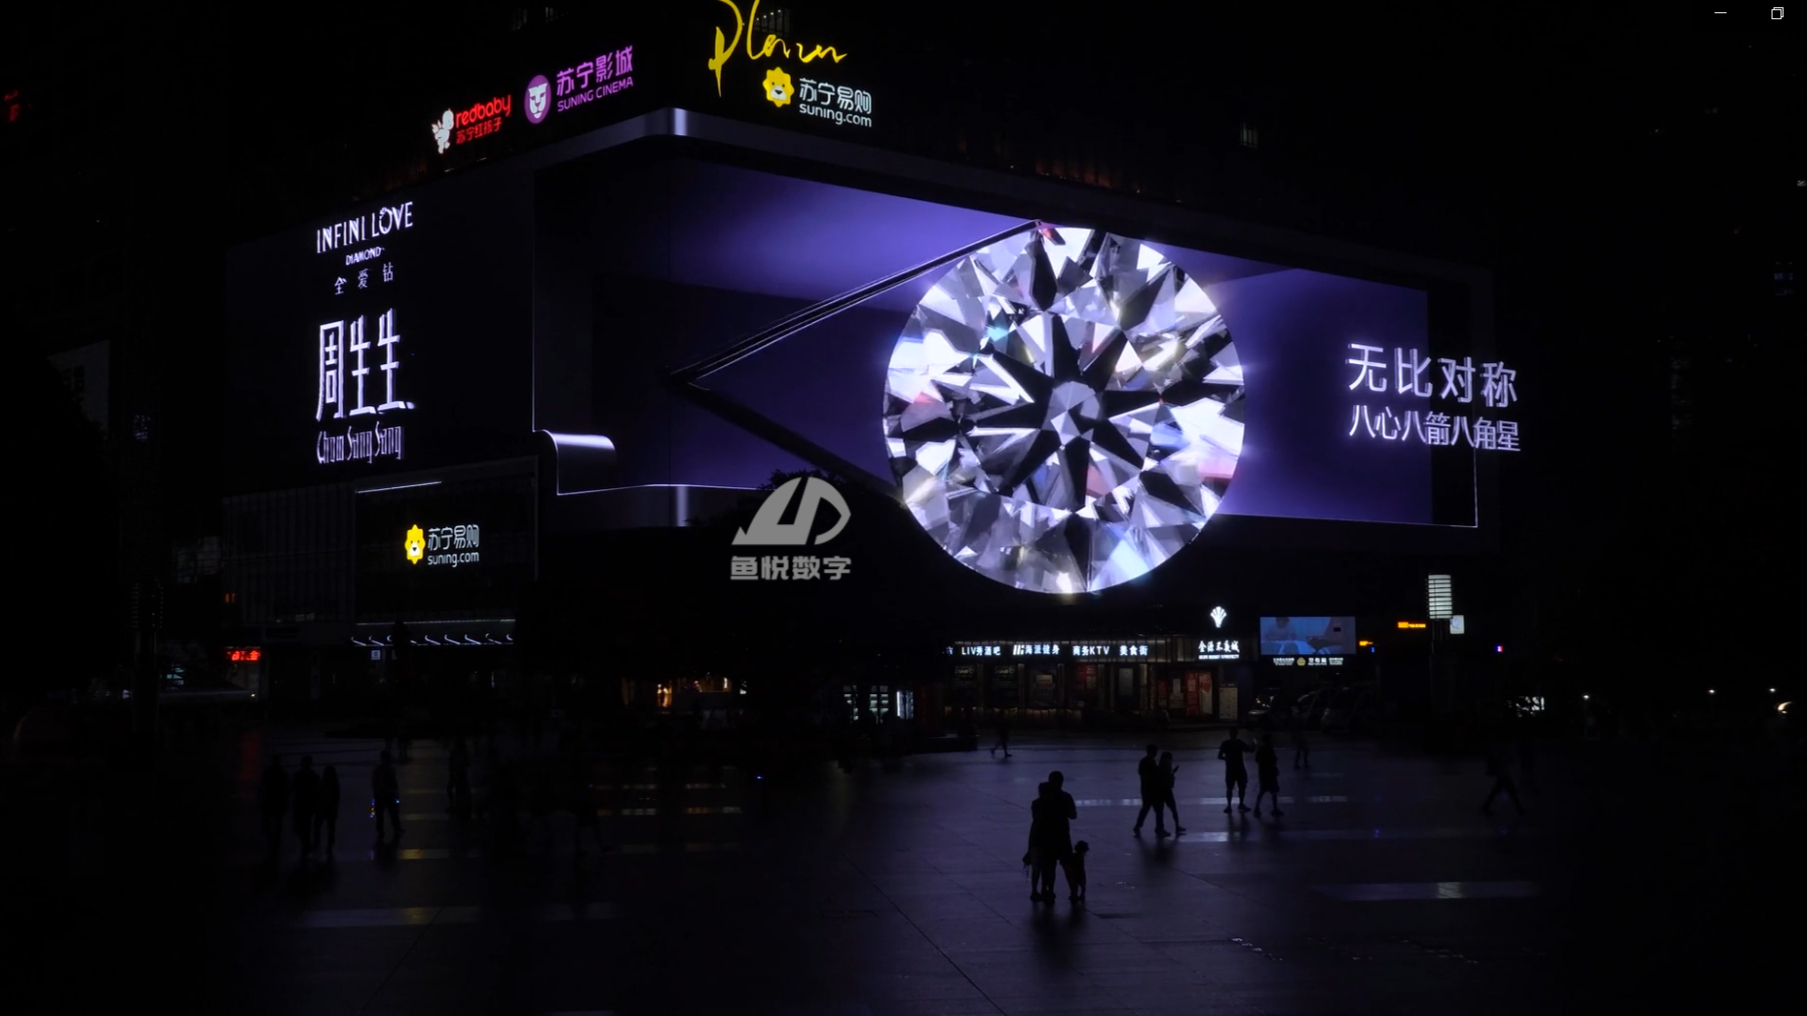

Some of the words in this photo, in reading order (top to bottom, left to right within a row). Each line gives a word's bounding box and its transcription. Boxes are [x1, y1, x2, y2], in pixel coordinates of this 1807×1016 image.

[556, 46, 633, 96] 苏宁影城
[456, 95, 511, 128] redbaby
[557, 90, 594, 112] SUNING
[595, 76, 633, 99] CINEMA
[799, 77, 872, 114] 苏宁易购
[456, 117, 502, 145] 苏宁红孩子
[799, 103, 872, 127] suning.com
[317, 215, 366, 254] INFINI
[371, 201, 413, 237] LOVE
[315, 308, 416, 421] 周生生
[1346, 343, 1518, 408] 无比对称
[316, 431, 345, 464] Chow
[346, 425, 373, 464] Sang
[374, 420, 403, 460] Sang
[1349, 404, 1521, 452] 八心八箭八角星
[427, 523, 480, 551] 苏宁易购
[427, 552, 480, 568] suning.com
[1072, 645, 1110, 656] 商务KTV
